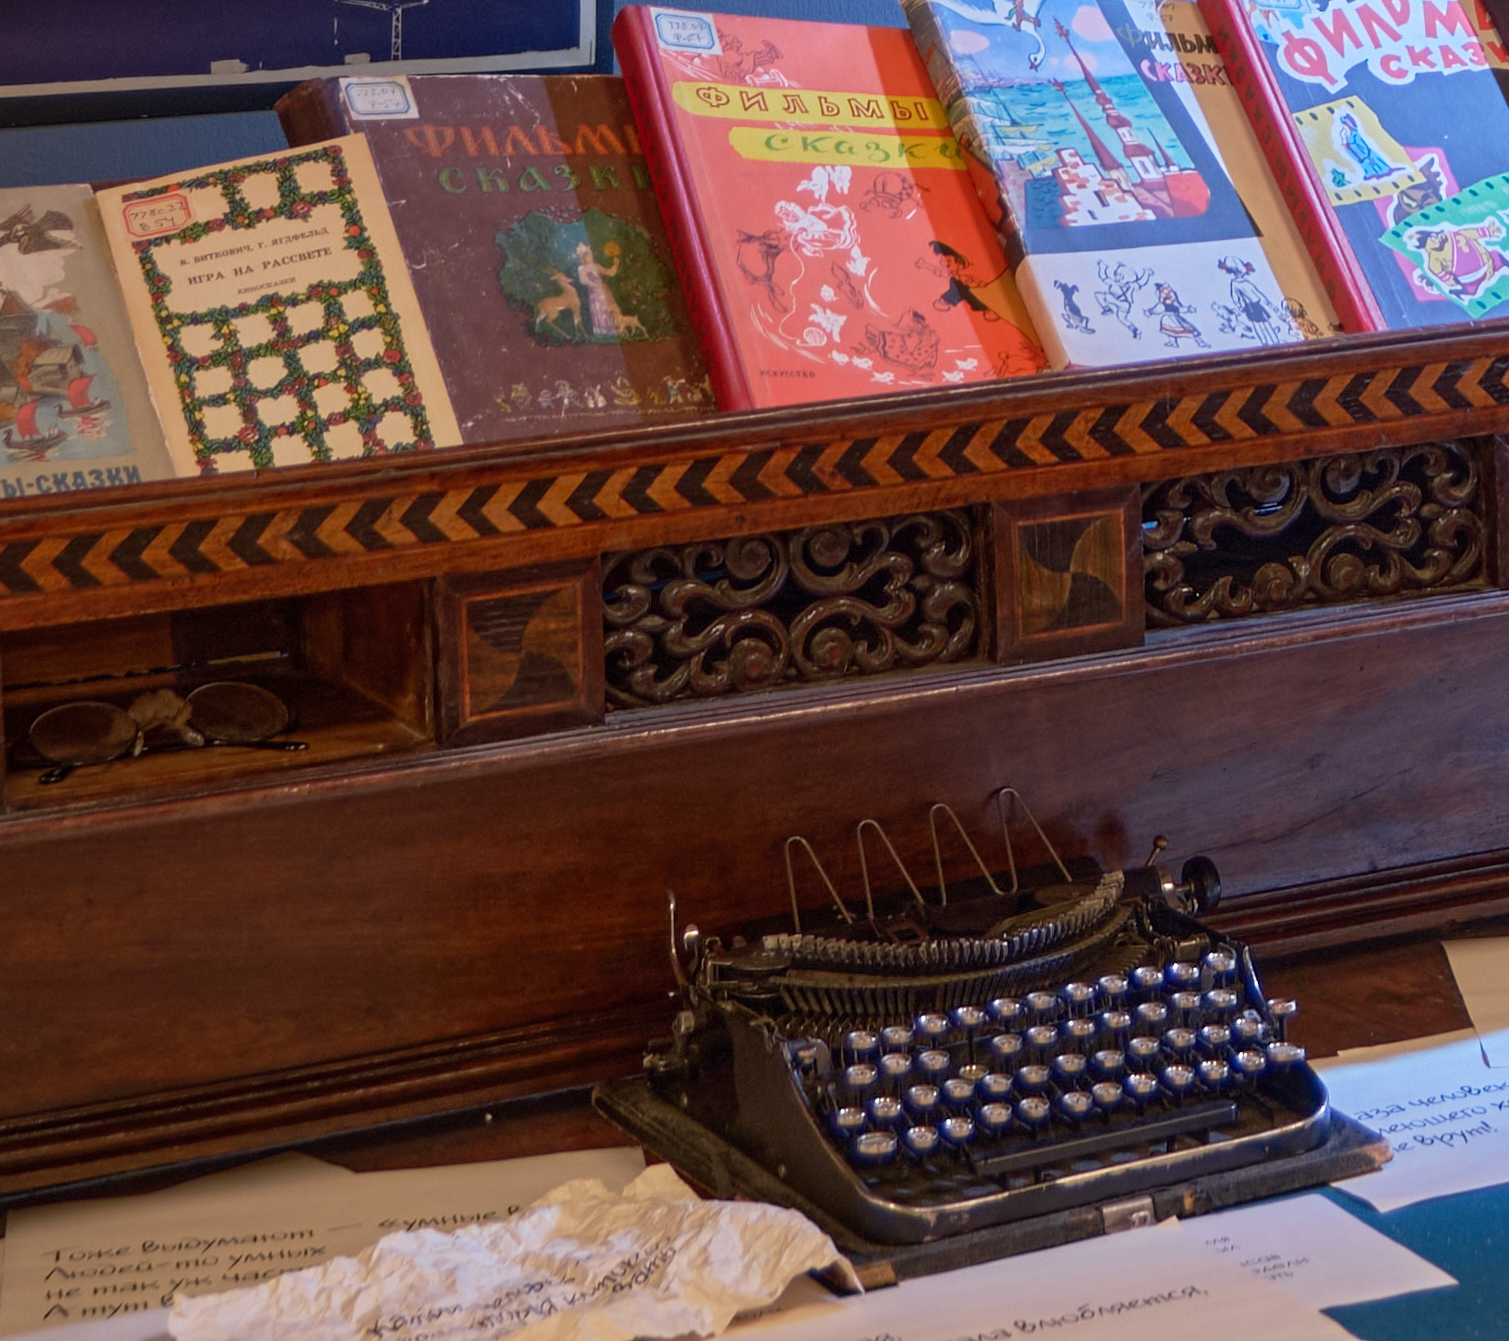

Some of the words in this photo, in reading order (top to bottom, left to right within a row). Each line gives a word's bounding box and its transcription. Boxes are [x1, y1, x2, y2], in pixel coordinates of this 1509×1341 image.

[696, 85, 929, 122] ФИЛЬМЫ
[188, 271, 225, 285] ИГРА
[234, 265, 254, 277] НА
[262, 247, 332, 271] РАССВЕТЕ
